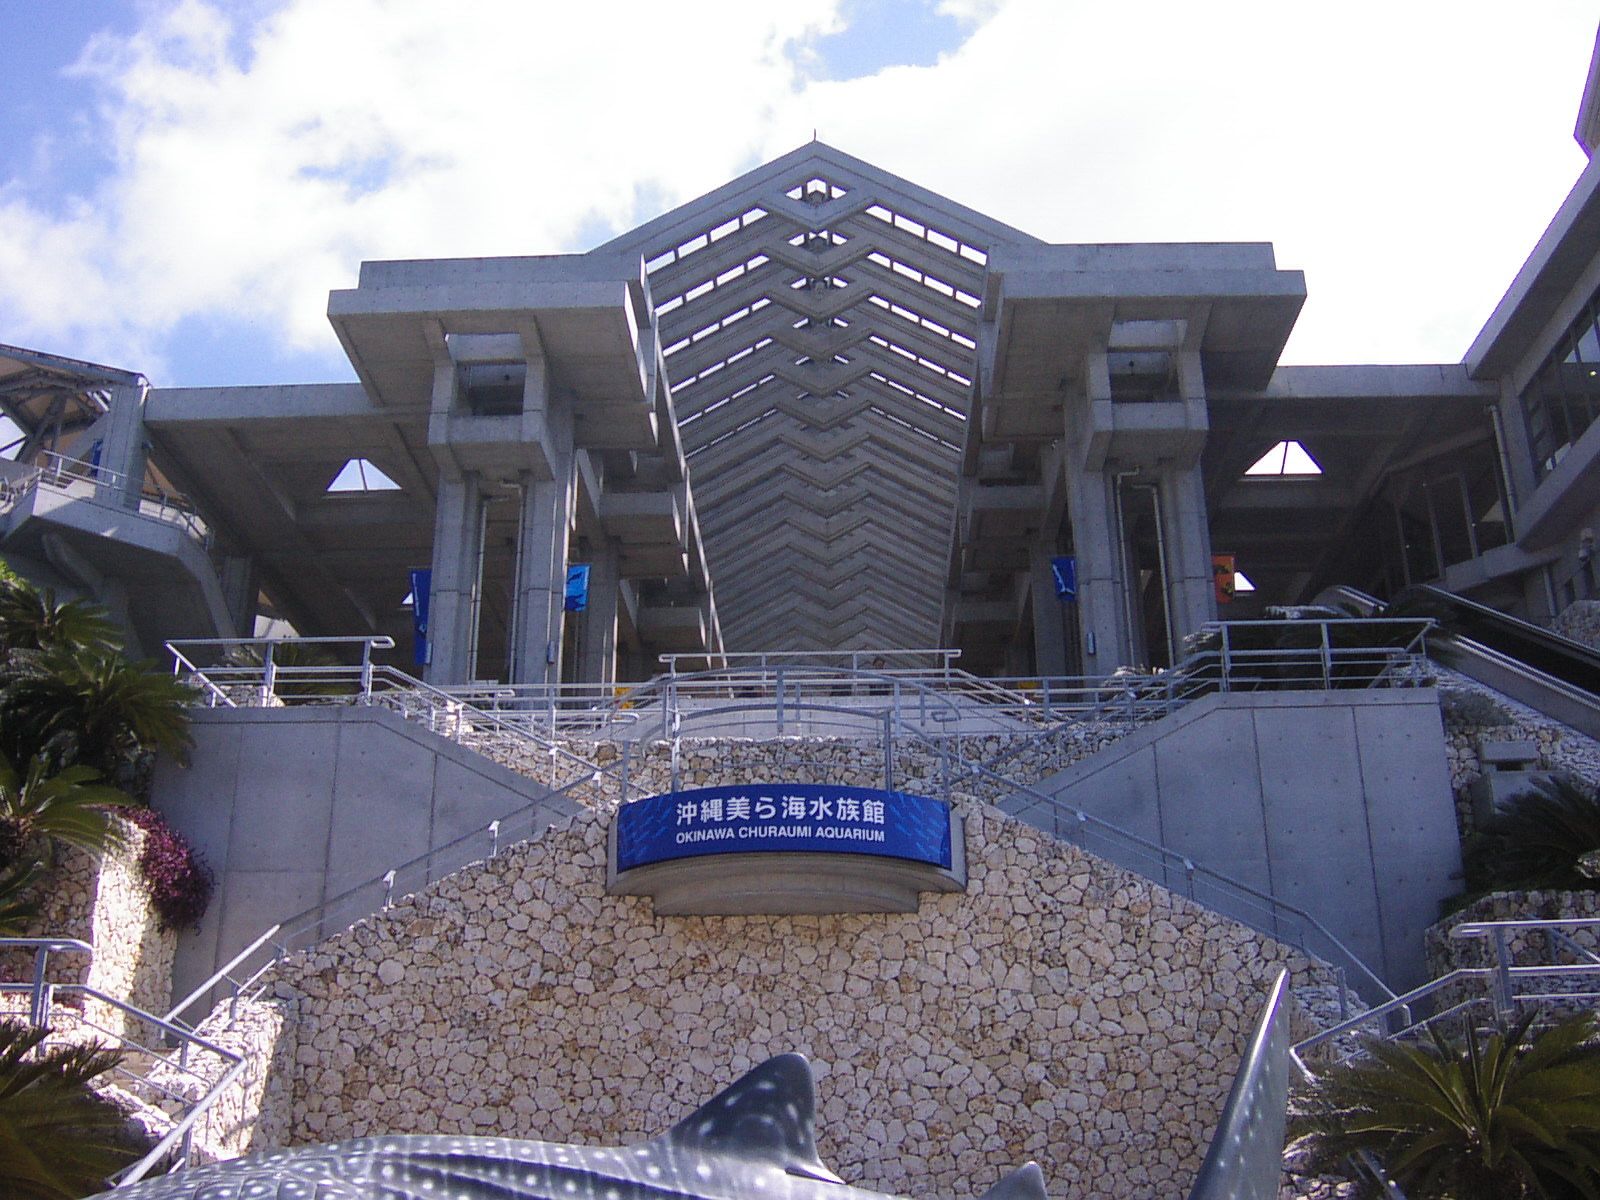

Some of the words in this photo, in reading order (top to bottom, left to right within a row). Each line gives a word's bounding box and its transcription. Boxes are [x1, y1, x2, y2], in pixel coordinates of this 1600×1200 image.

[676, 796, 885, 826] 沖縄美ら海水族館
[676, 827, 735, 844] OKINAWA
[738, 826, 812, 838] CHURAUMI
[815, 827, 885, 842] AQUARIUM
